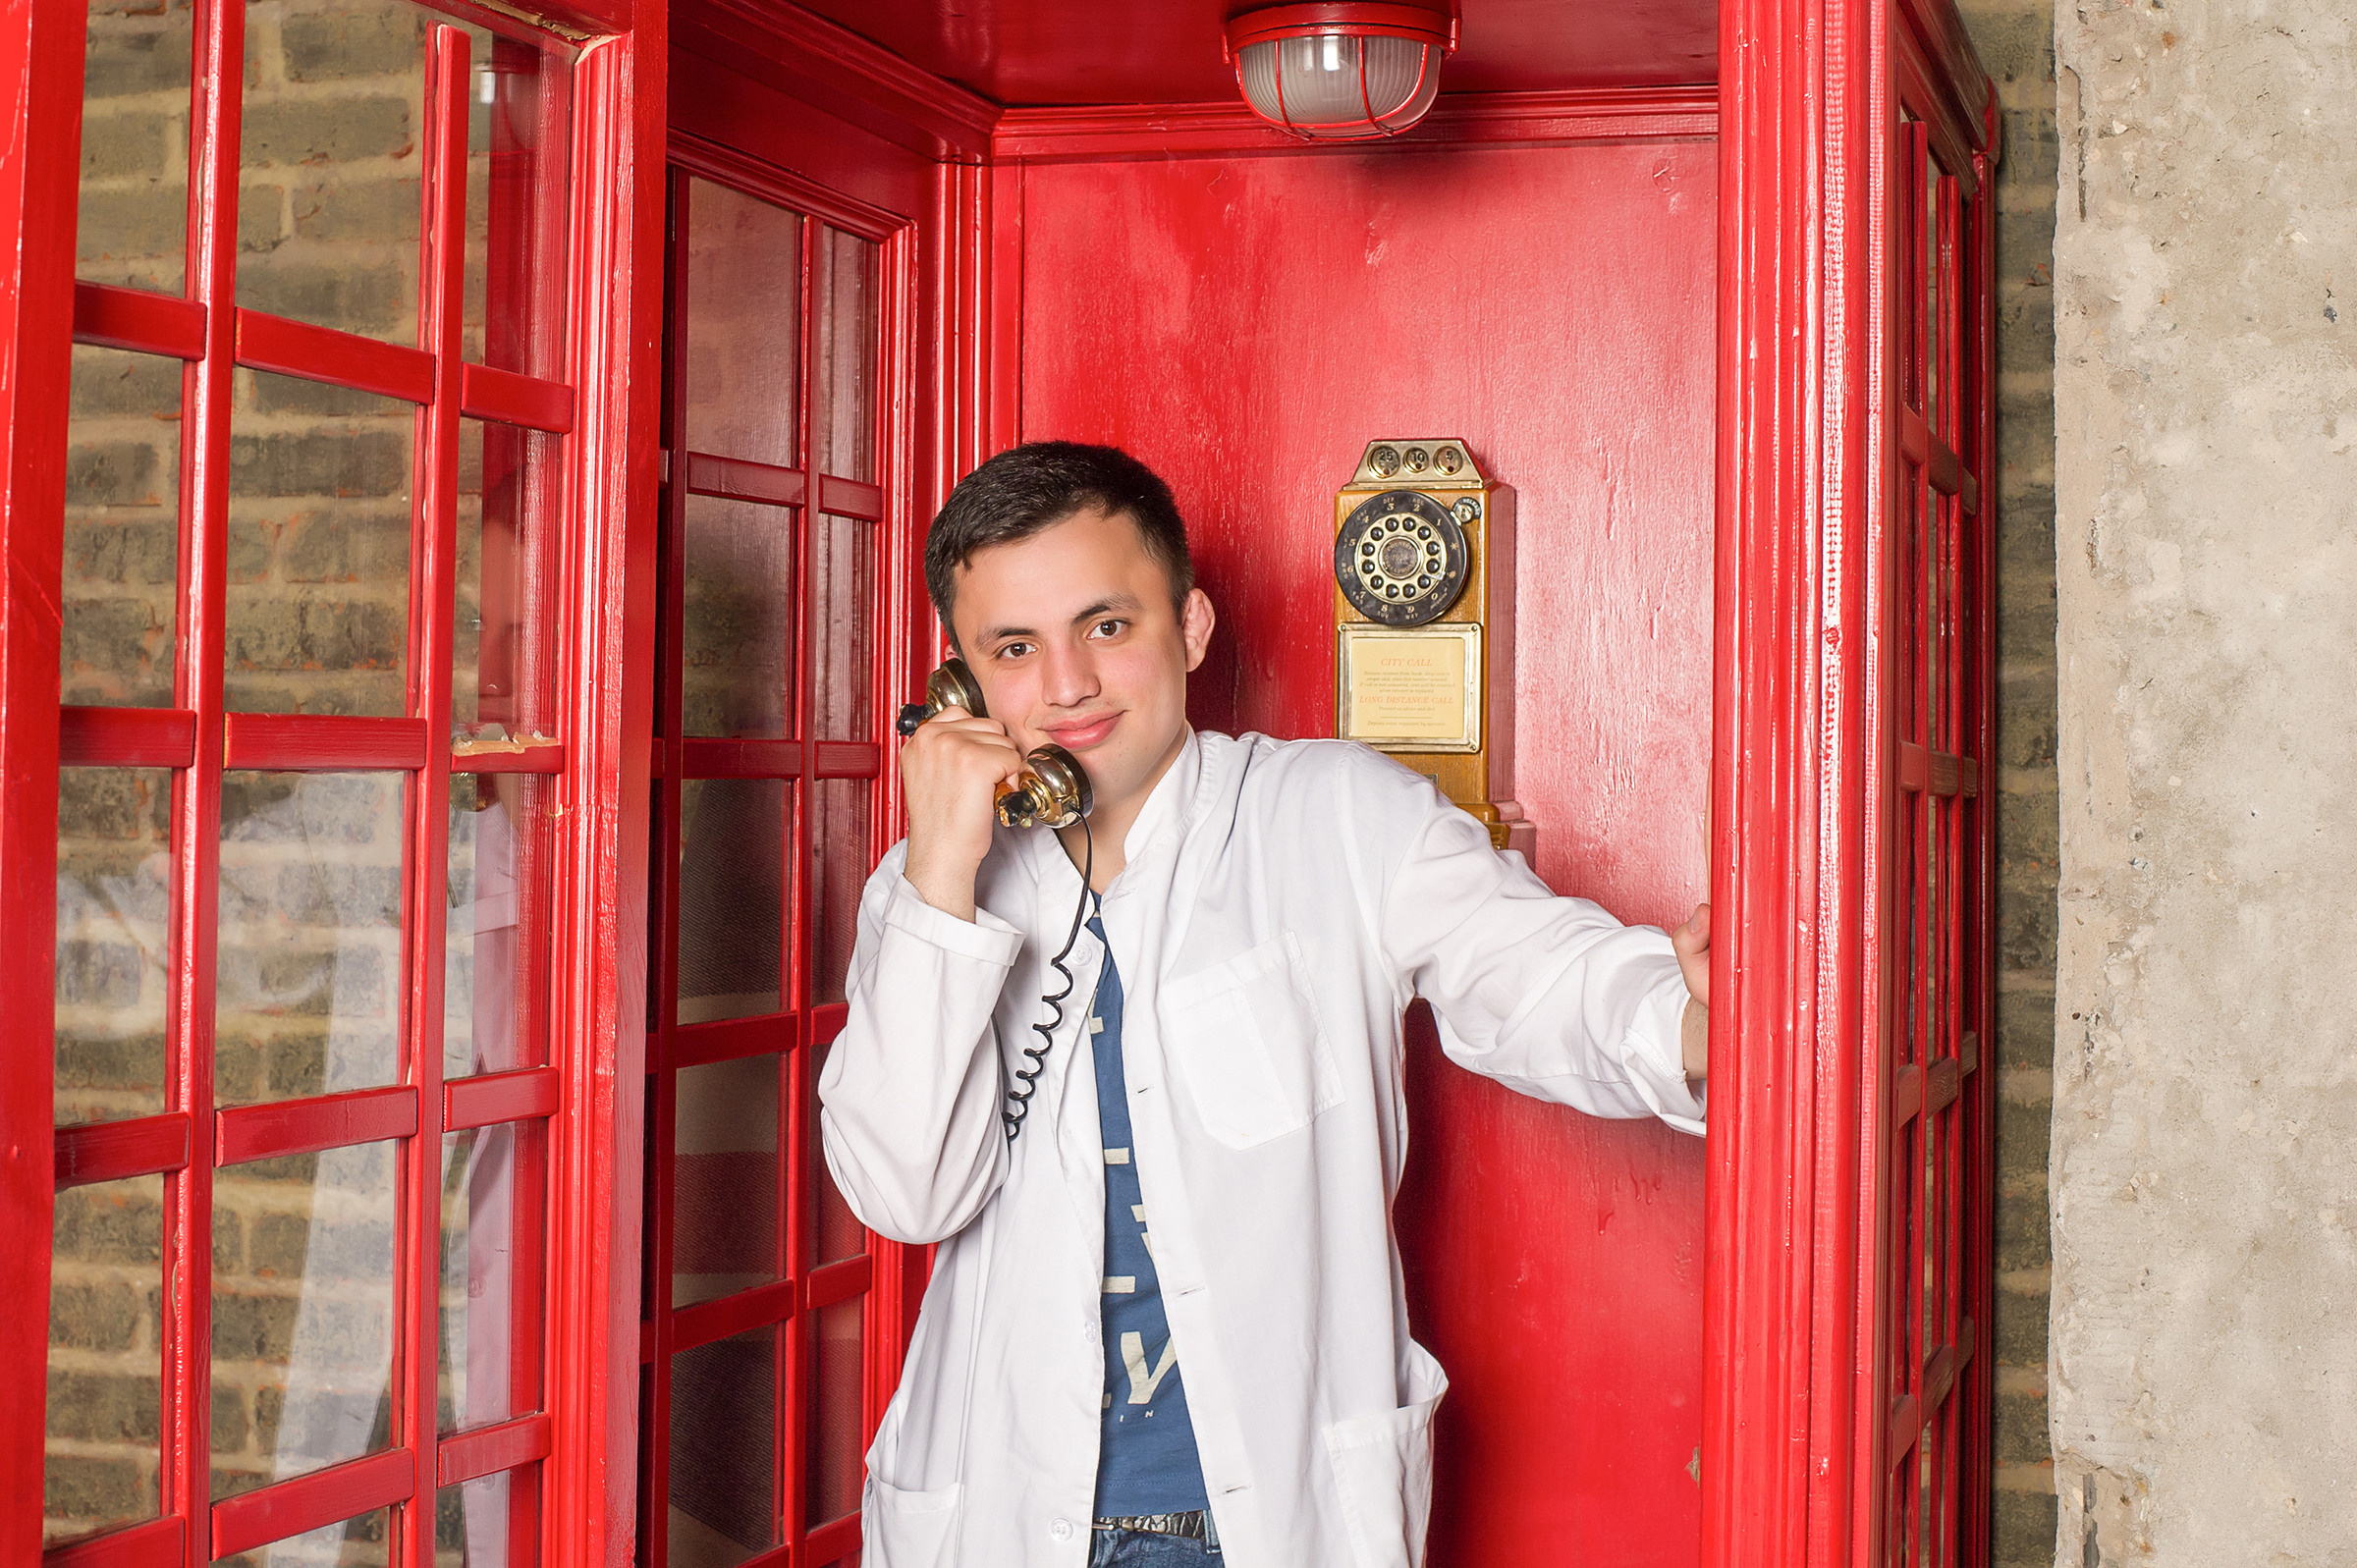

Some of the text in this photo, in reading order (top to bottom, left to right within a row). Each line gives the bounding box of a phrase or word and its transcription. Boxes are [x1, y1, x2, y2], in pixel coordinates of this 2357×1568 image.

[1378, 451, 1394, 461] 25
[1412, 452, 1426, 462] 10
[1446, 451, 1453, 460] 5
[1386, 503, 1395, 512] 3
[1436, 517, 1442, 526] 1
[1348, 538, 1356, 547] 5
[1380, 604, 1389, 613] 8
[1407, 605, 1415, 614] 9
[1380, 658, 1434, 667] CITY CALL
[1431, 696, 1453, 705] CALL
